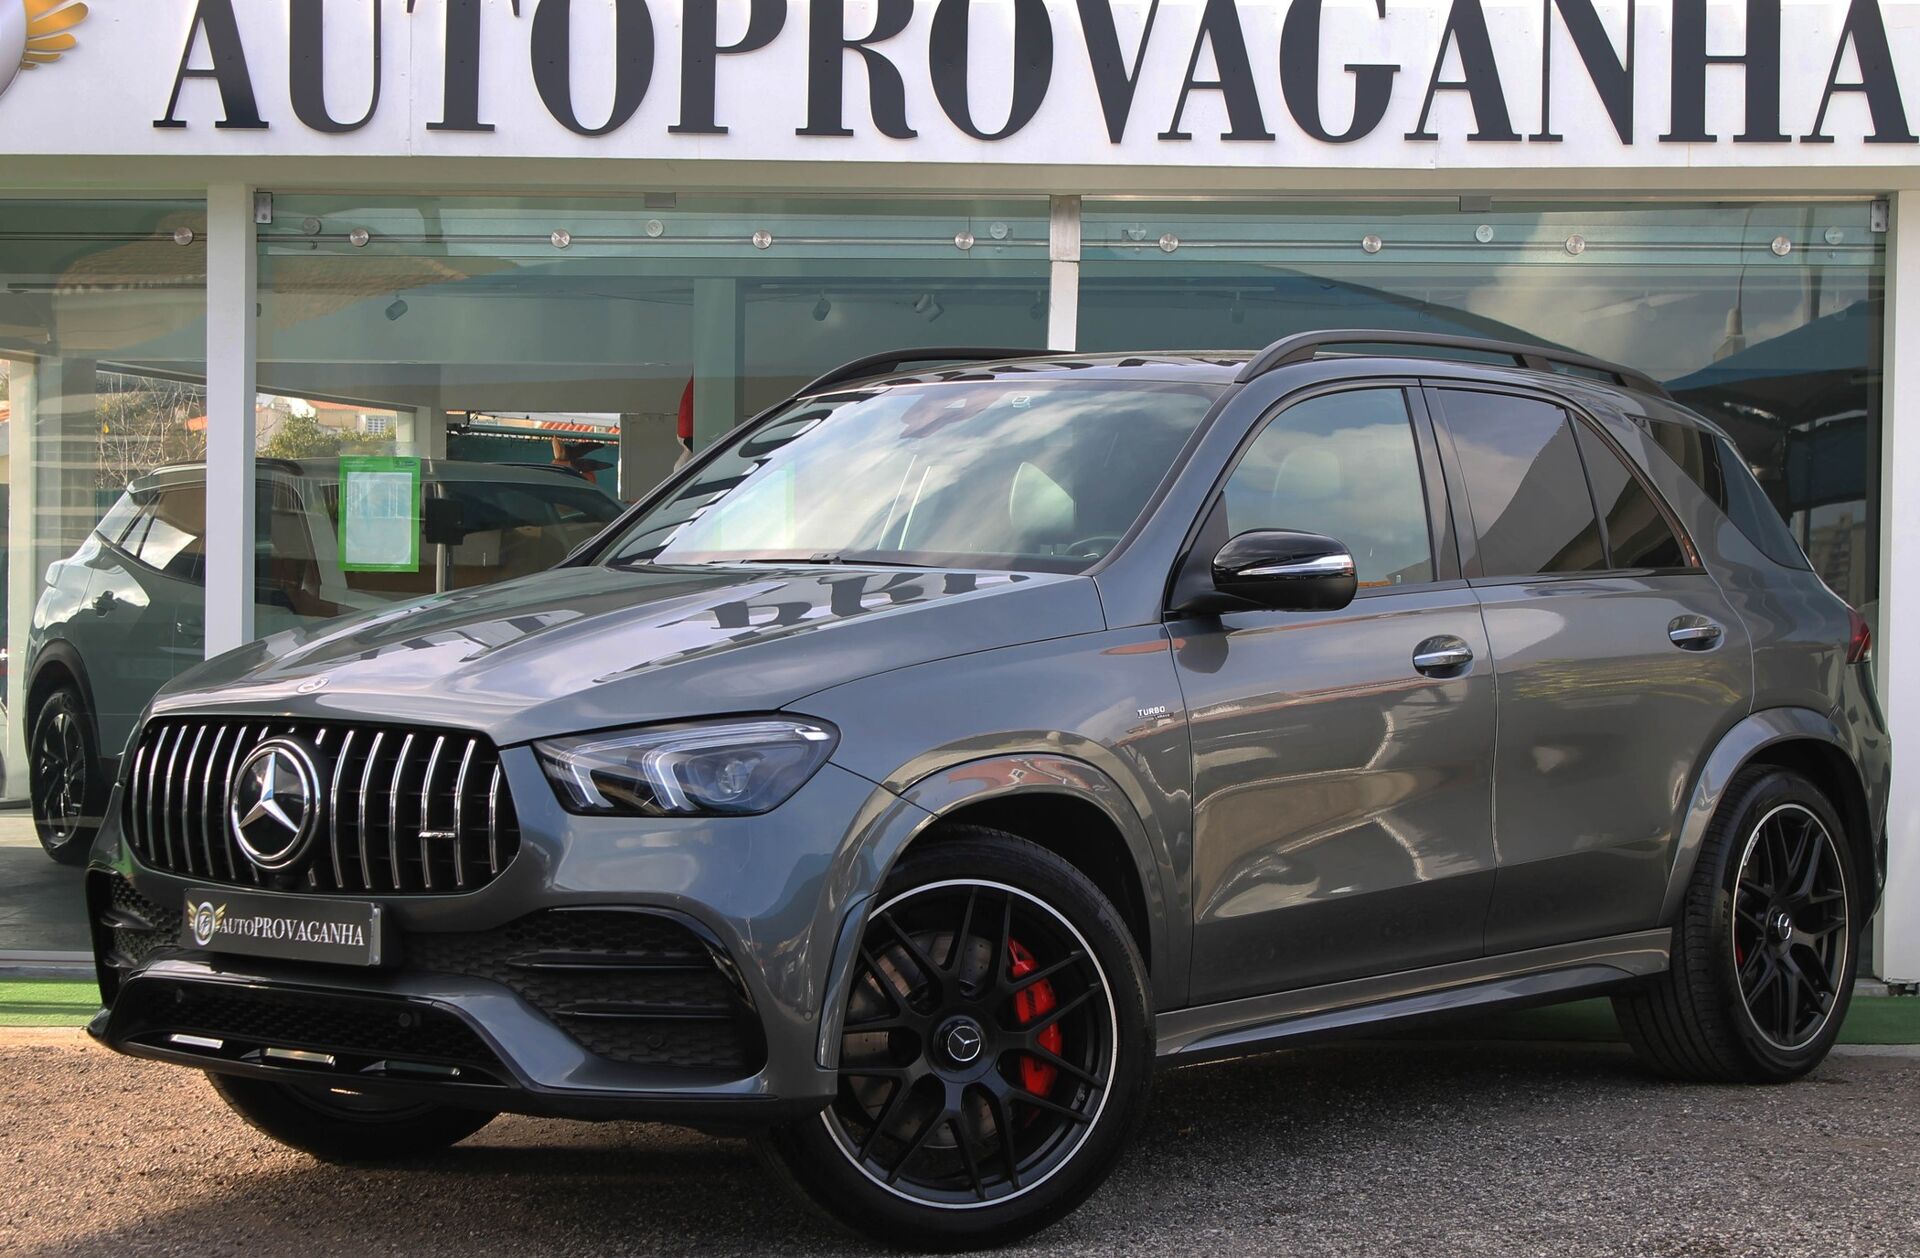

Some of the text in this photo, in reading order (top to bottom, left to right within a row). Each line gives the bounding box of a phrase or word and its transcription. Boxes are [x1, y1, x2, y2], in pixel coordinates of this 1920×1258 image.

[153, 0, 1919, 145] AUTOPROVAGANHA
[1137, 705, 1166, 717] TURBO
[219, 916, 365, 946] AUTOPROVAGANHA
